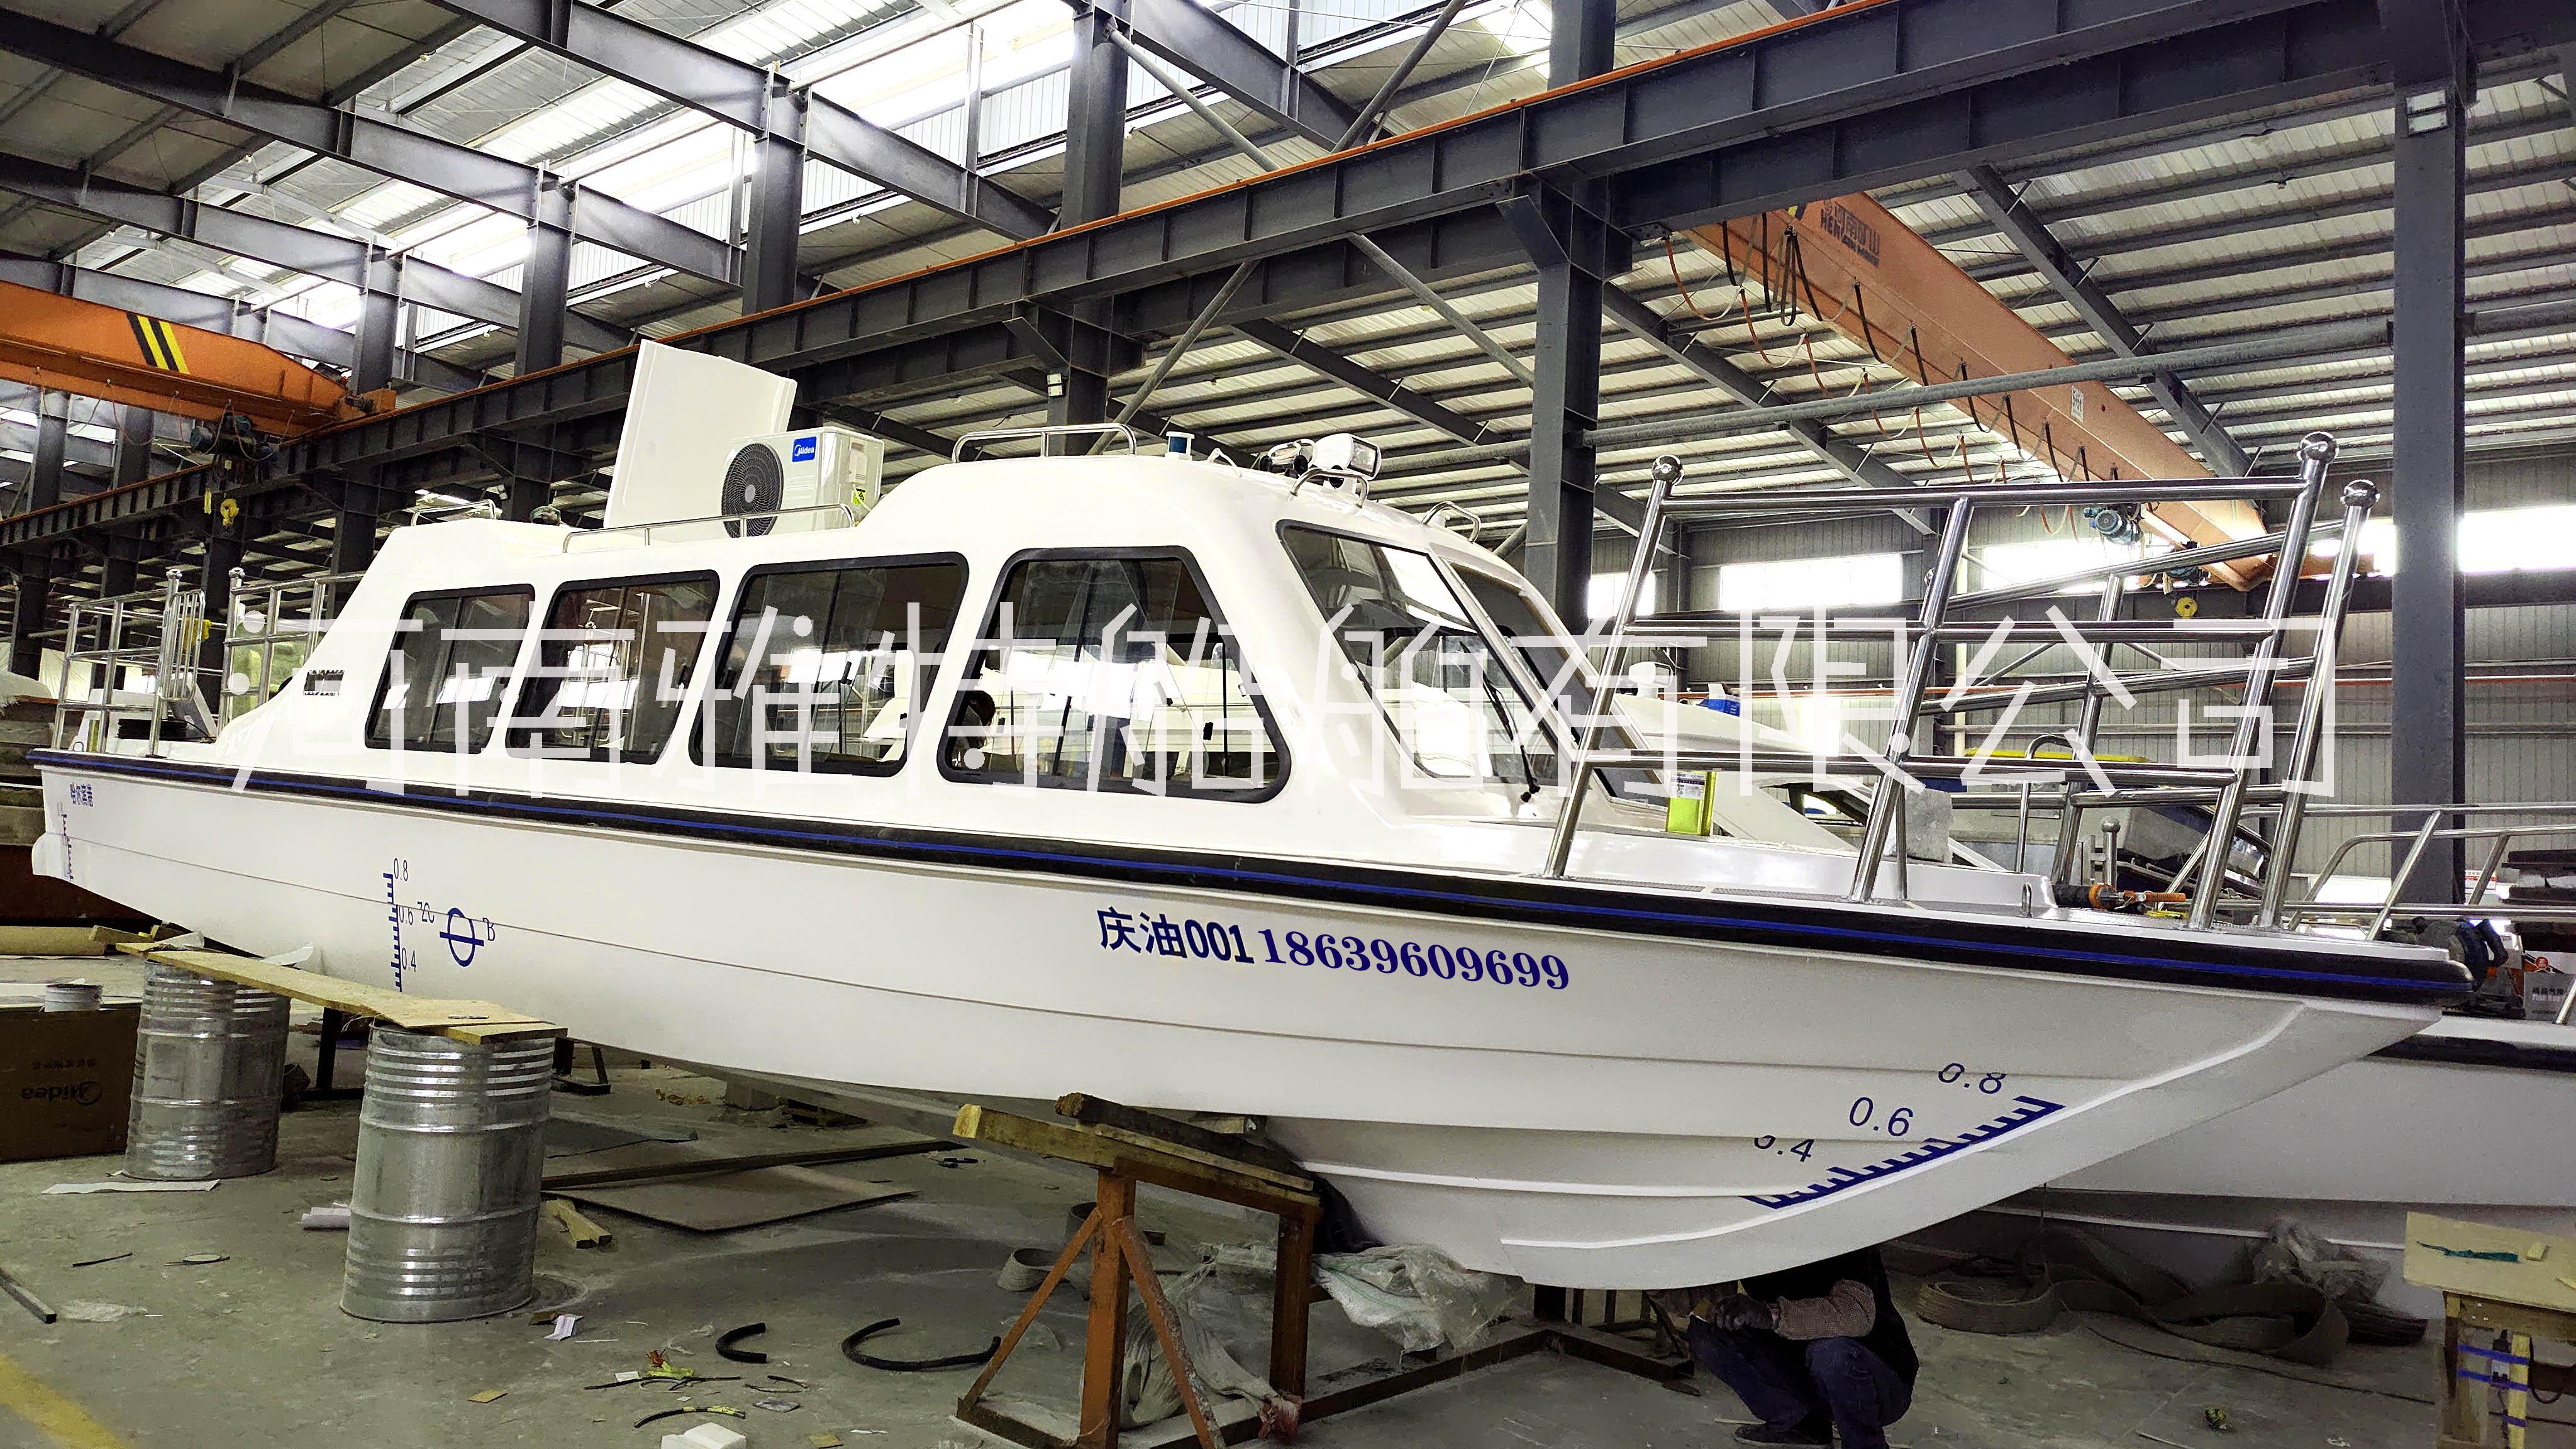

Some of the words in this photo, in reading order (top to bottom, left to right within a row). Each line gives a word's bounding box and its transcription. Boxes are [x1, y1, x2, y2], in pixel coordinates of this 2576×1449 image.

[794, 444, 814, 457] Midea
[393, 858, 408, 881] 0.8
[399, 905, 413, 925] 0.6
[1097, 906, 1255, 964] 庆油001
[402, 947, 416, 972] 0.4
[1938, 1063, 2008, 1094] 0.8
[1850, 1097, 1913, 1136] 0.6
